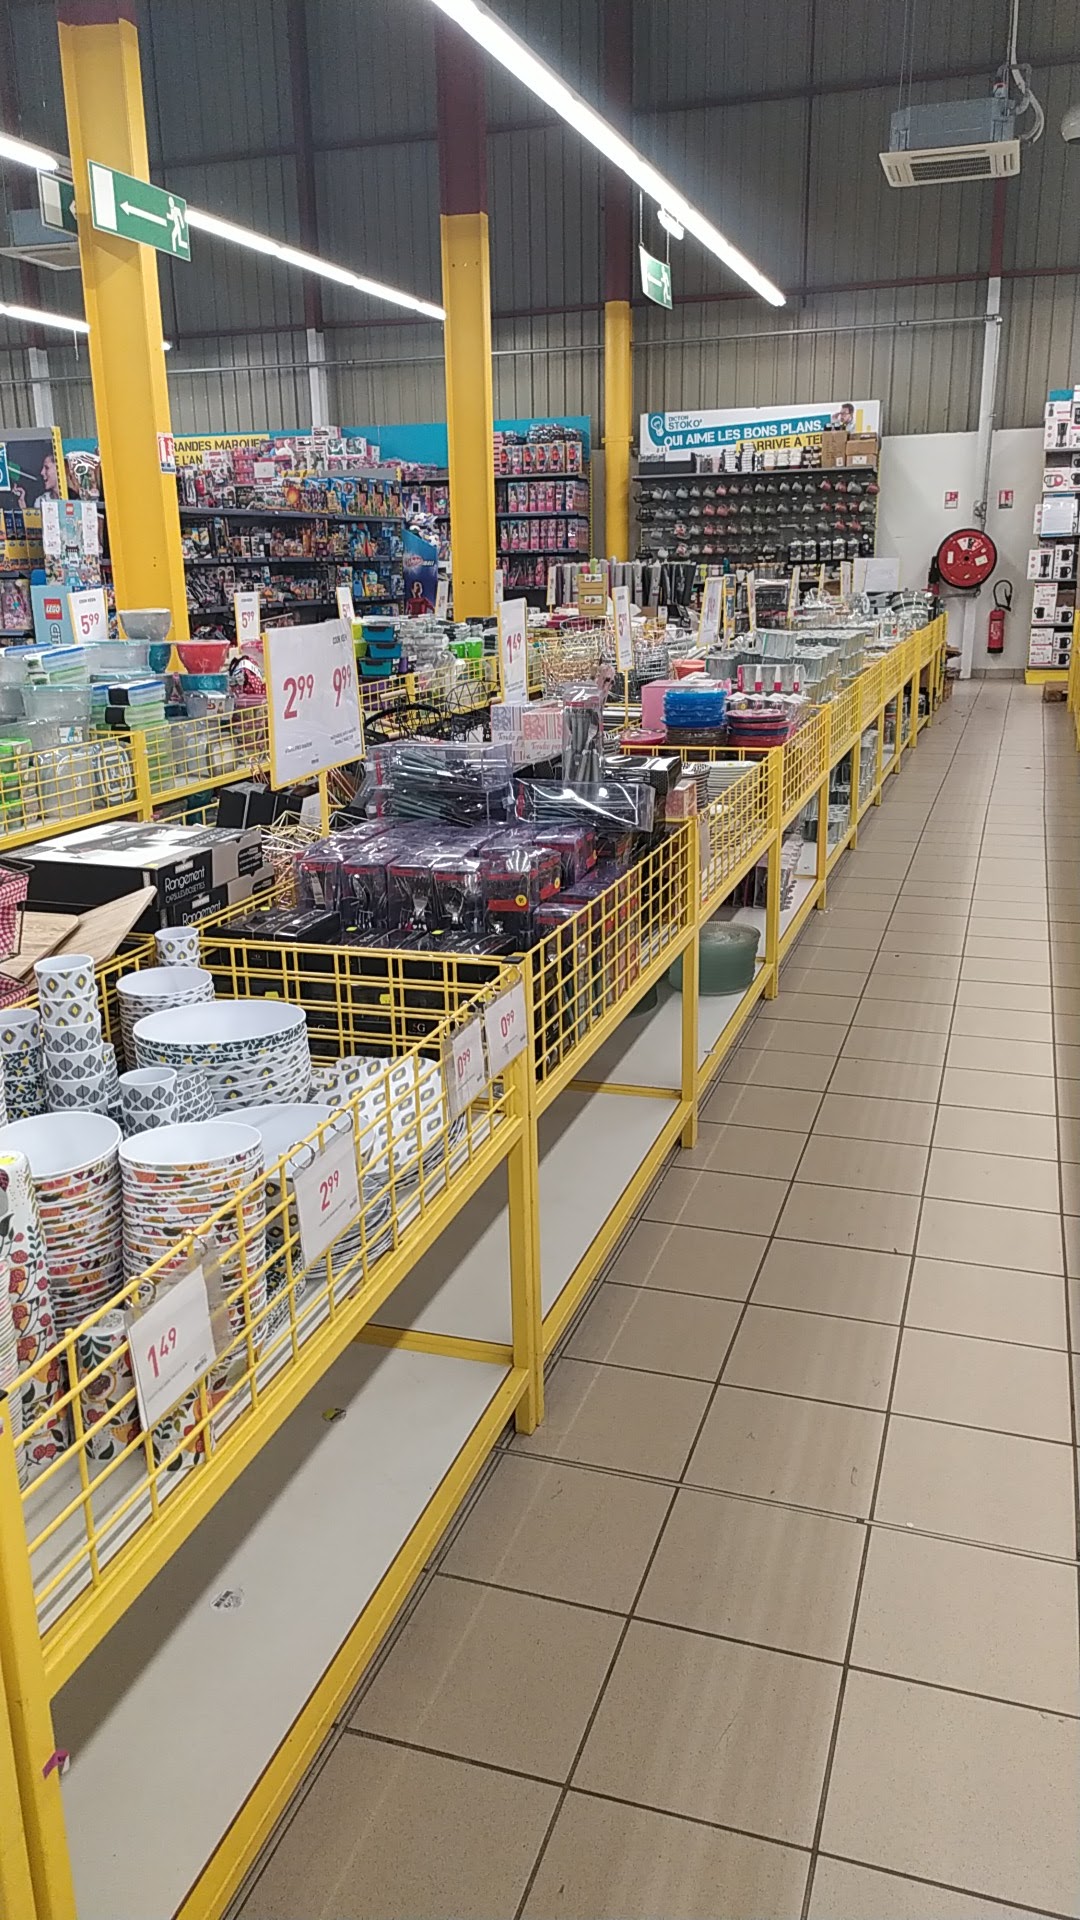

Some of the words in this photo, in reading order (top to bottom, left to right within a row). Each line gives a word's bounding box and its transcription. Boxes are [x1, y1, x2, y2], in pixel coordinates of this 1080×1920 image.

[173, 440, 212, 452] RANDES
[214, 438, 267, 451] MARQUE
[664, 434, 683, 447] QUI
[686, 431, 715, 445] AIME
[718, 428, 740, 441] LES
[744, 425, 778, 439] BONS
[806, 434, 823, 446] TE
[46, 604, 61, 614] LEGO
[164, 865, 206, 893] Rangement
[182, 900, 221, 926] Rangement
